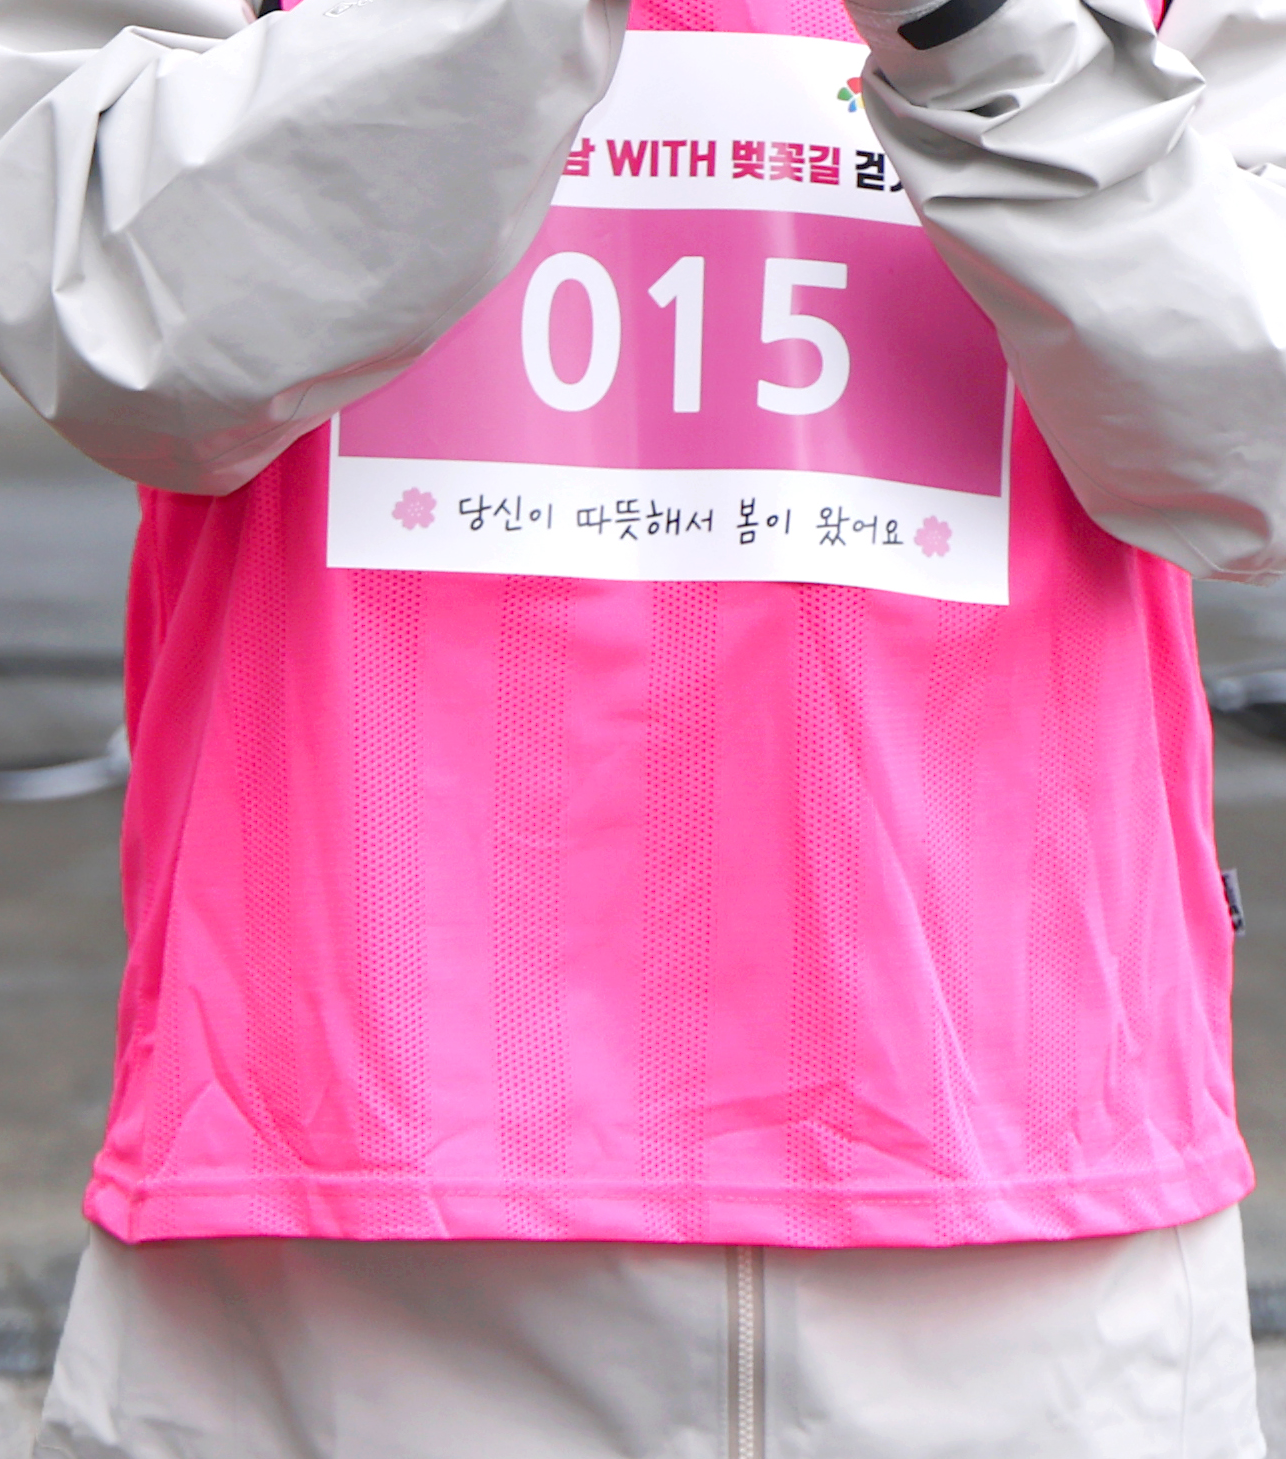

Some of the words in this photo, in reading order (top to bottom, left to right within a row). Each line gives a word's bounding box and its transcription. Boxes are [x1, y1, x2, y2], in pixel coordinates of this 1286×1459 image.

[606, 139, 716, 177] WITH
[731, 139, 841, 185] 벚꽃길
[855, 150, 904, 192] 걷
[521, 251, 851, 416] 015
[458, 494, 552, 532] 당신이
[576, 498, 713, 540] 따뜻해서
[736, 497, 791, 545] 봄이
[816, 506, 904, 546] 왔어요
